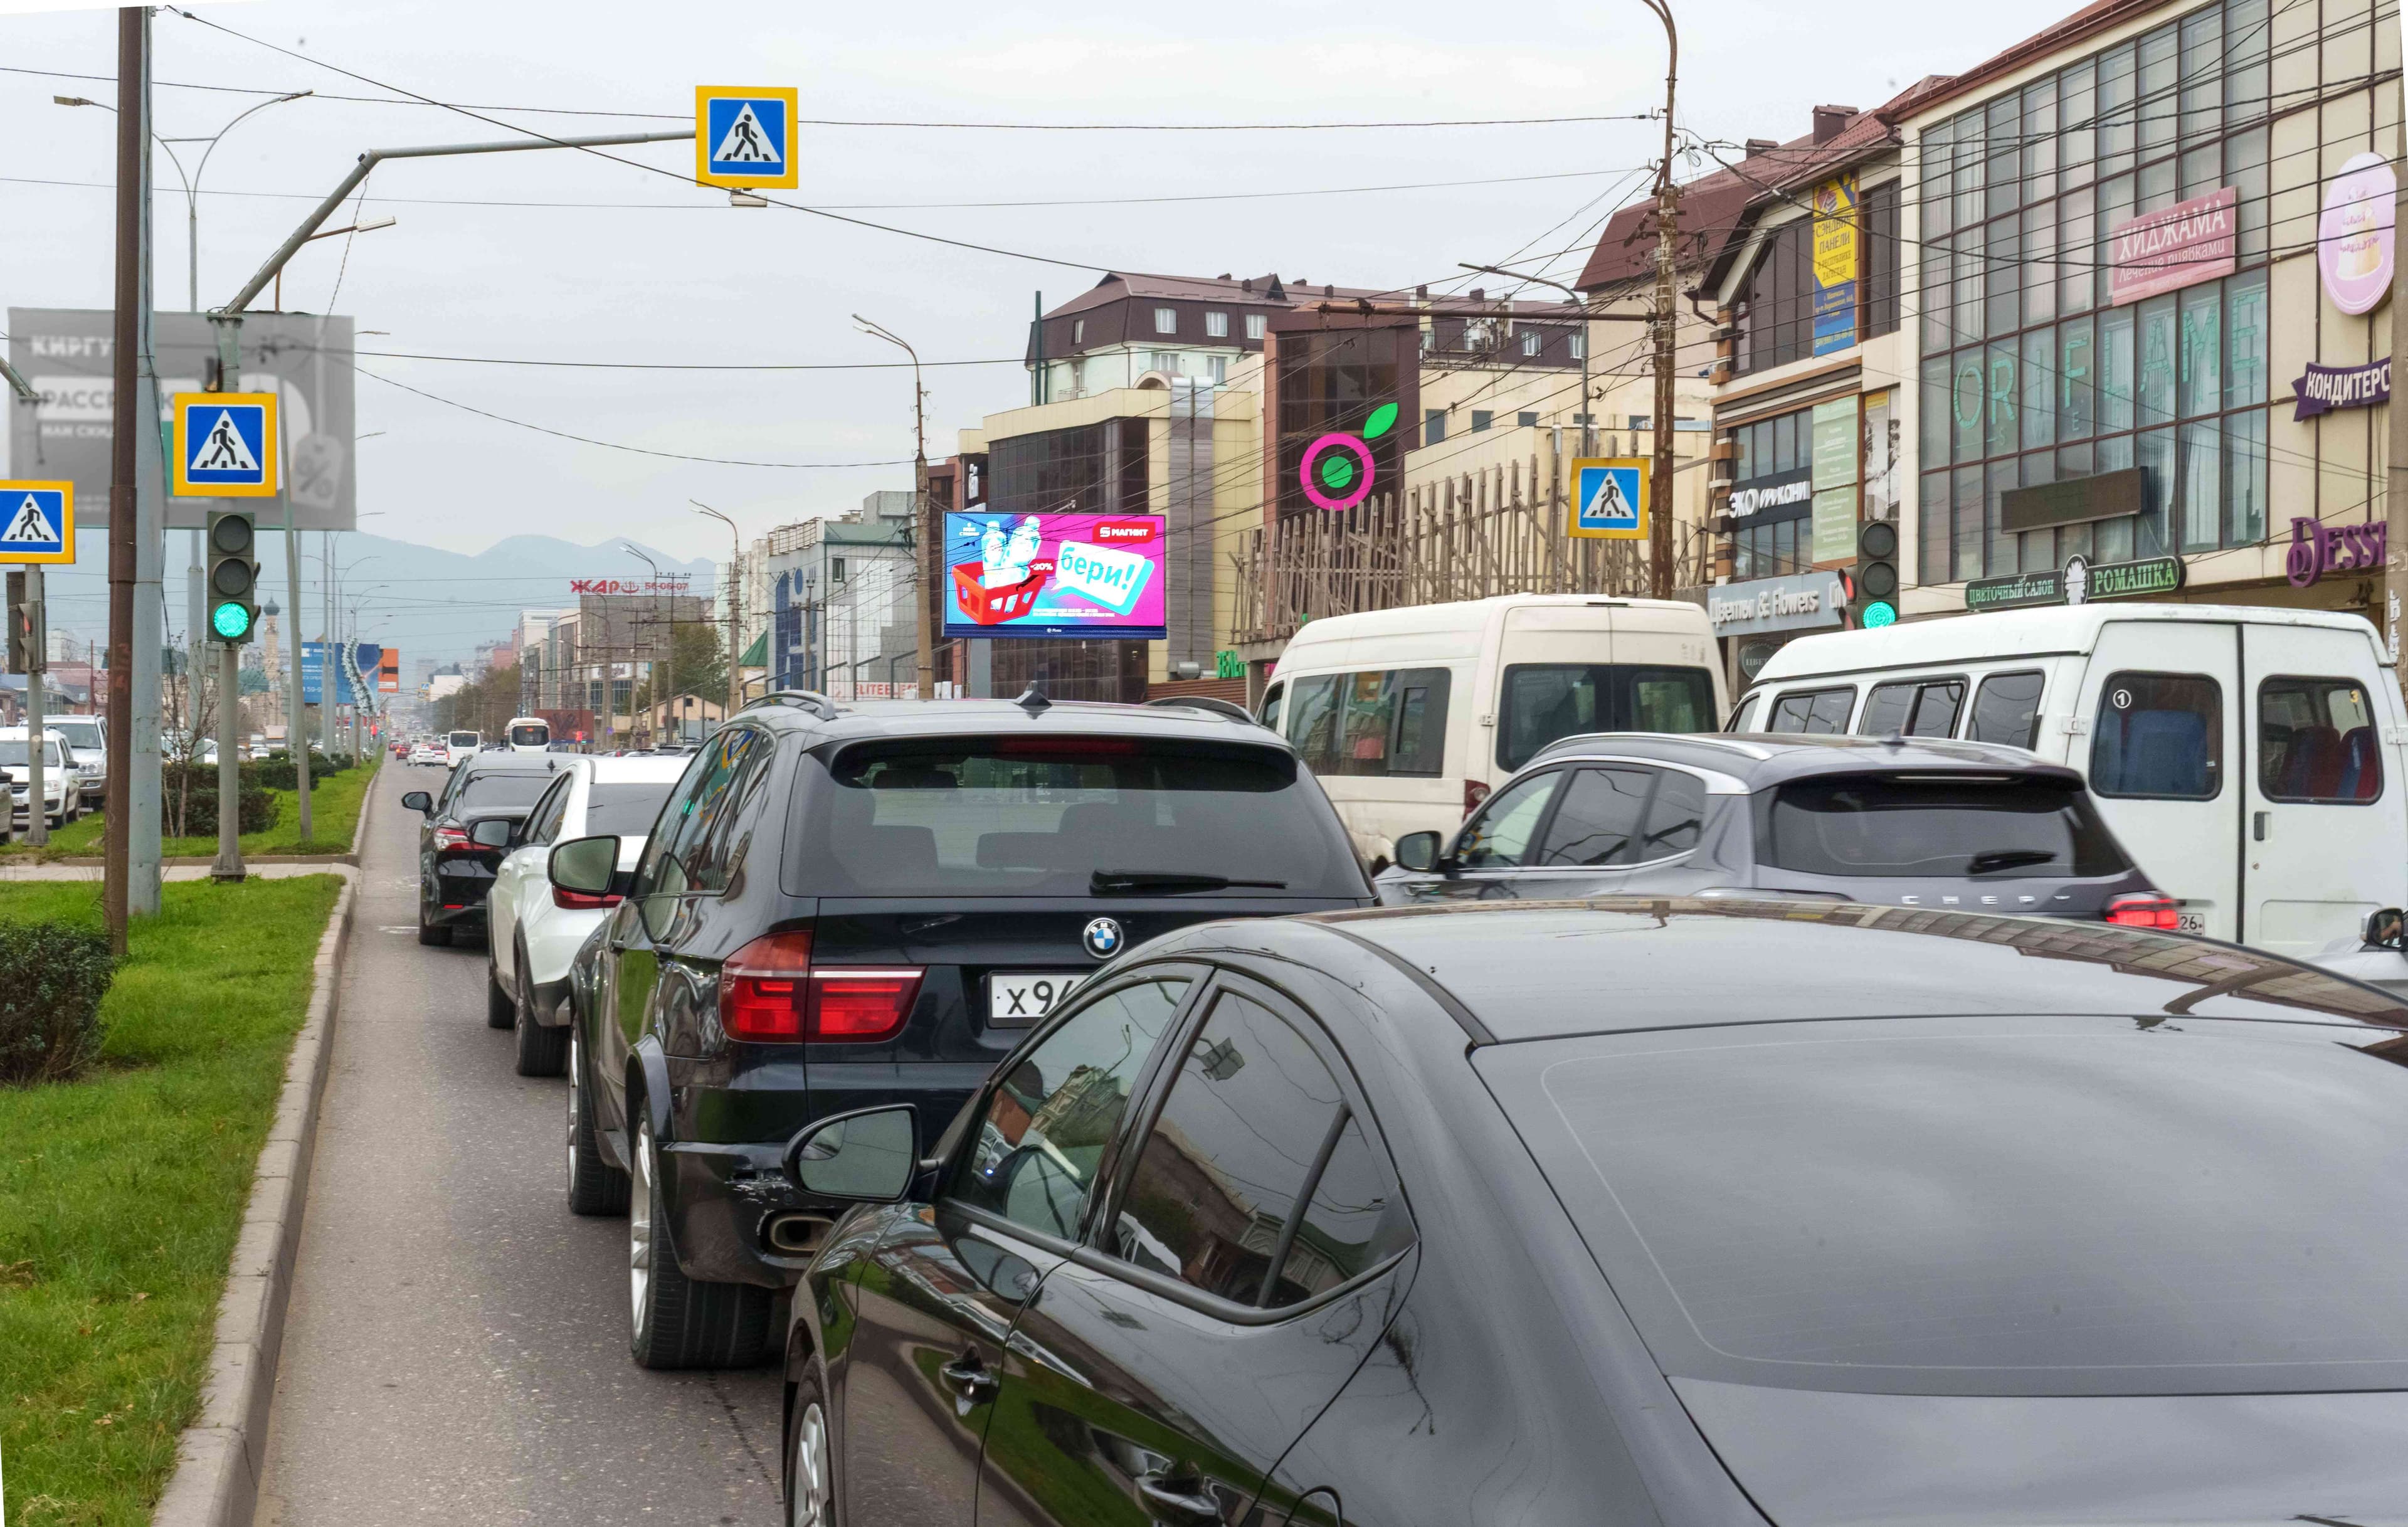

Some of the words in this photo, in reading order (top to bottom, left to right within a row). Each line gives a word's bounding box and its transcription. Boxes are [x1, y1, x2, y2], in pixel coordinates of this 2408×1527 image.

[1819, 230, 1851, 255] ПАНЕЛИ
[2119, 199, 2226, 262] ХИДЖАМА
[2167, 240, 2226, 268] пиявками
[1953, 291, 2261, 430] ORIFLAME
[2305, 362, 2391, 406] КОНДИТЕРС
[1729, 489, 1760, 519] ЭКО
[1759, 480, 1811, 509] ткани
[1111, 528, 1149, 537] МАГНИТ
[570, 579, 620, 594] ЖАР
[1061, 546, 1136, 591] бери!
[1969, 578, 2024, 604] ЦВЕТОЧНЫЙ
[2024, 578, 2055, 597] САЛОН
[2094, 561, 2177, 594] РОМАШКА
[1756, 591, 1770, 618] &
[1772, 586, 1820, 616] Flowers
